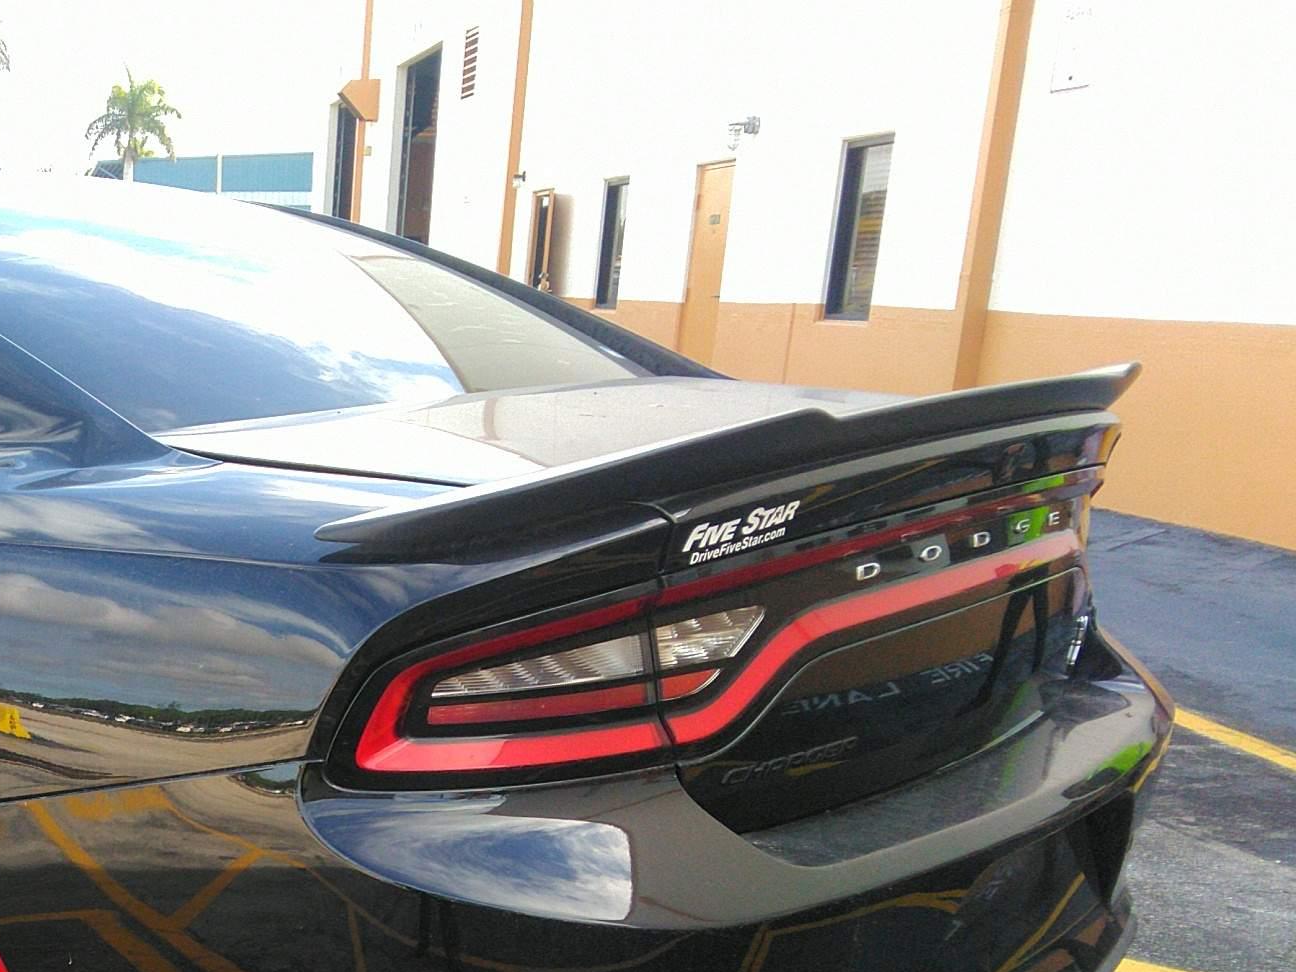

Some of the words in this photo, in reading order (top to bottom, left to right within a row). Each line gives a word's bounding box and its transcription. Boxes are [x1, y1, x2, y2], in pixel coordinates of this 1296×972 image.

[683, 517, 742, 553] FIVE
[742, 500, 800, 536] STAR
[690, 527, 786, 566] DriveFiveStar.com
[856, 511, 1061, 581] DODGE
